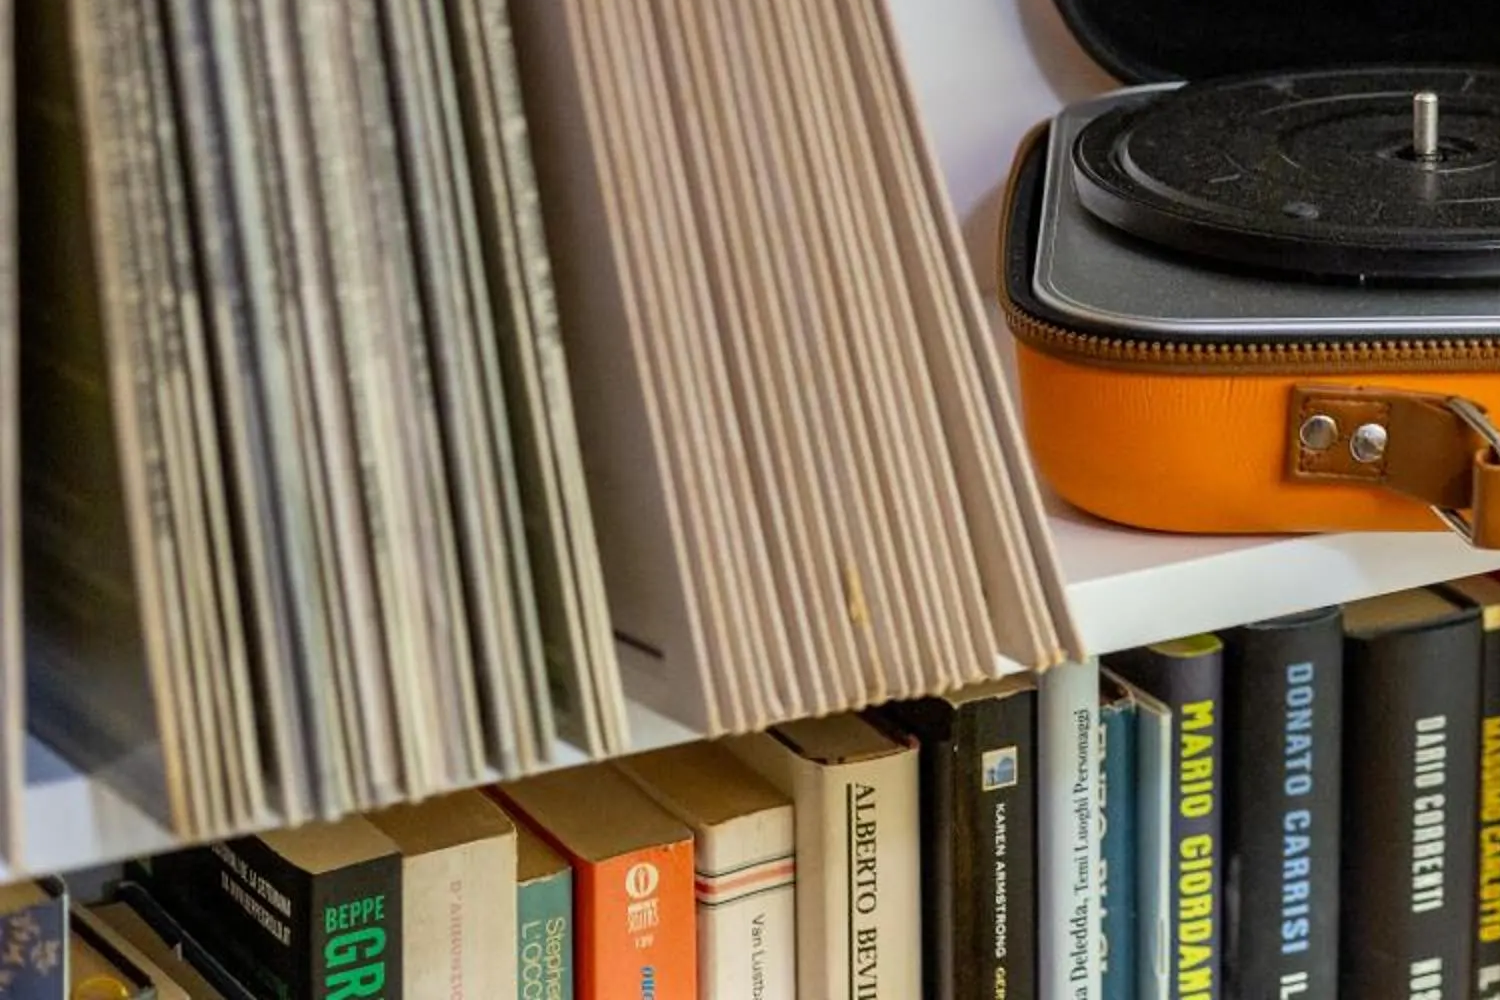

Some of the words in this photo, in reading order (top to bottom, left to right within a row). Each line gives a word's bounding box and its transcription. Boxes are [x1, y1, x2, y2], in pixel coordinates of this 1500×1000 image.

[1072, 708, 1091, 795] Personaggi
[1179, 699, 1214, 818] MARIO
[1284, 661, 1314, 796] DONATO
[1413, 715, 1447, 789] DARIO
[855, 782, 877, 915] ALBERTO
[995, 802, 1007, 857] KAREN
[1411, 794, 1445, 913] CORRENTI
[325, 894, 385, 934] BEPPE
[995, 861, 1008, 959] ARMSTRONG
[1280, 810, 1311, 954] CARRISI
[521, 921, 544, 1000] L'OCC
[751, 912, 767, 948] Van
[857, 927, 878, 1000] BEVI
